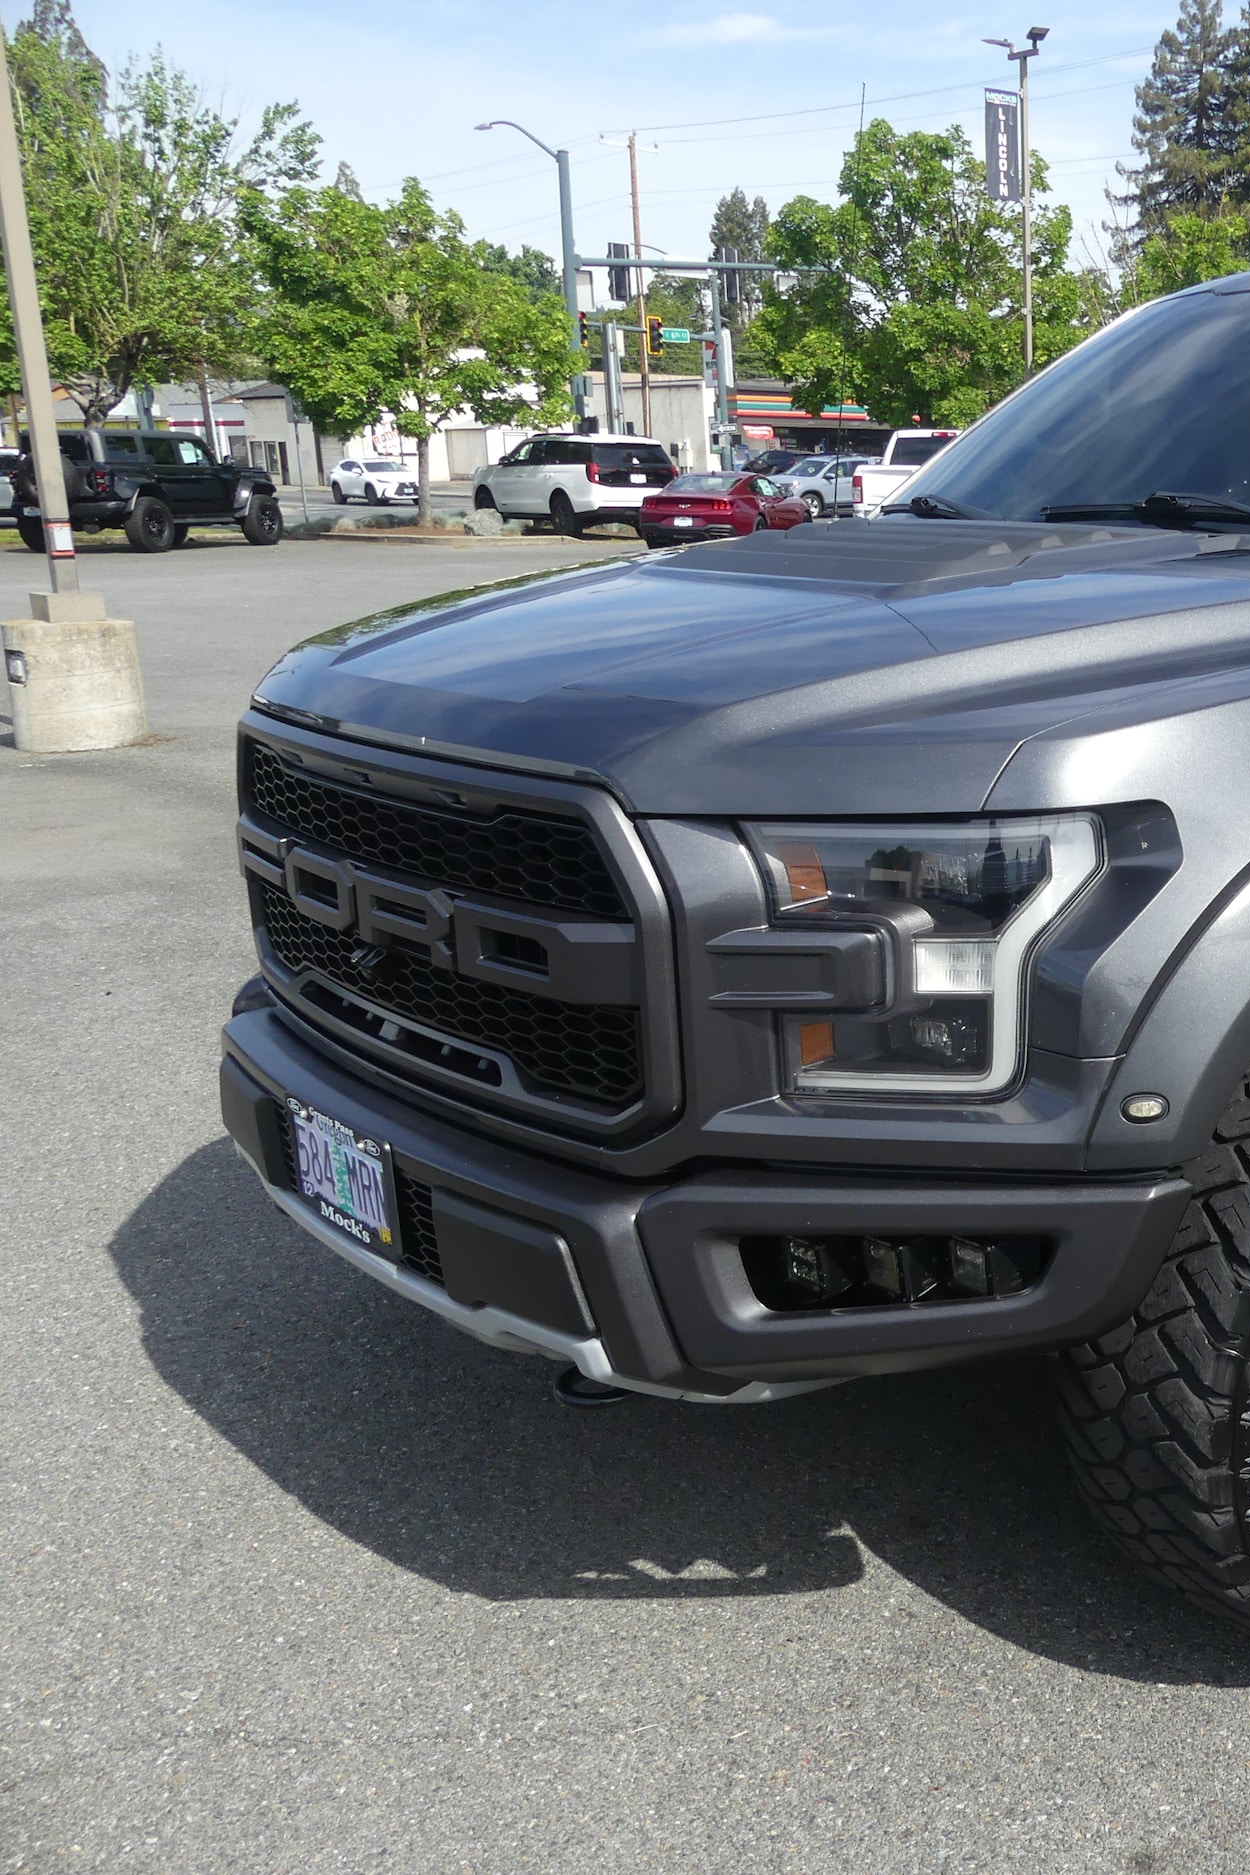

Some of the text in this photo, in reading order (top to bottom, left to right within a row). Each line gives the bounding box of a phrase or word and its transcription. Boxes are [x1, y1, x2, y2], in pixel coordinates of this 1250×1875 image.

[998, 107, 1008, 197] LINCOLN
[236, 812, 600, 1005] FORD
[308, 1106, 354, 1137] Grants Pass
[296, 1124, 336, 1195] 584
[320, 1201, 371, 1244] Mock's
